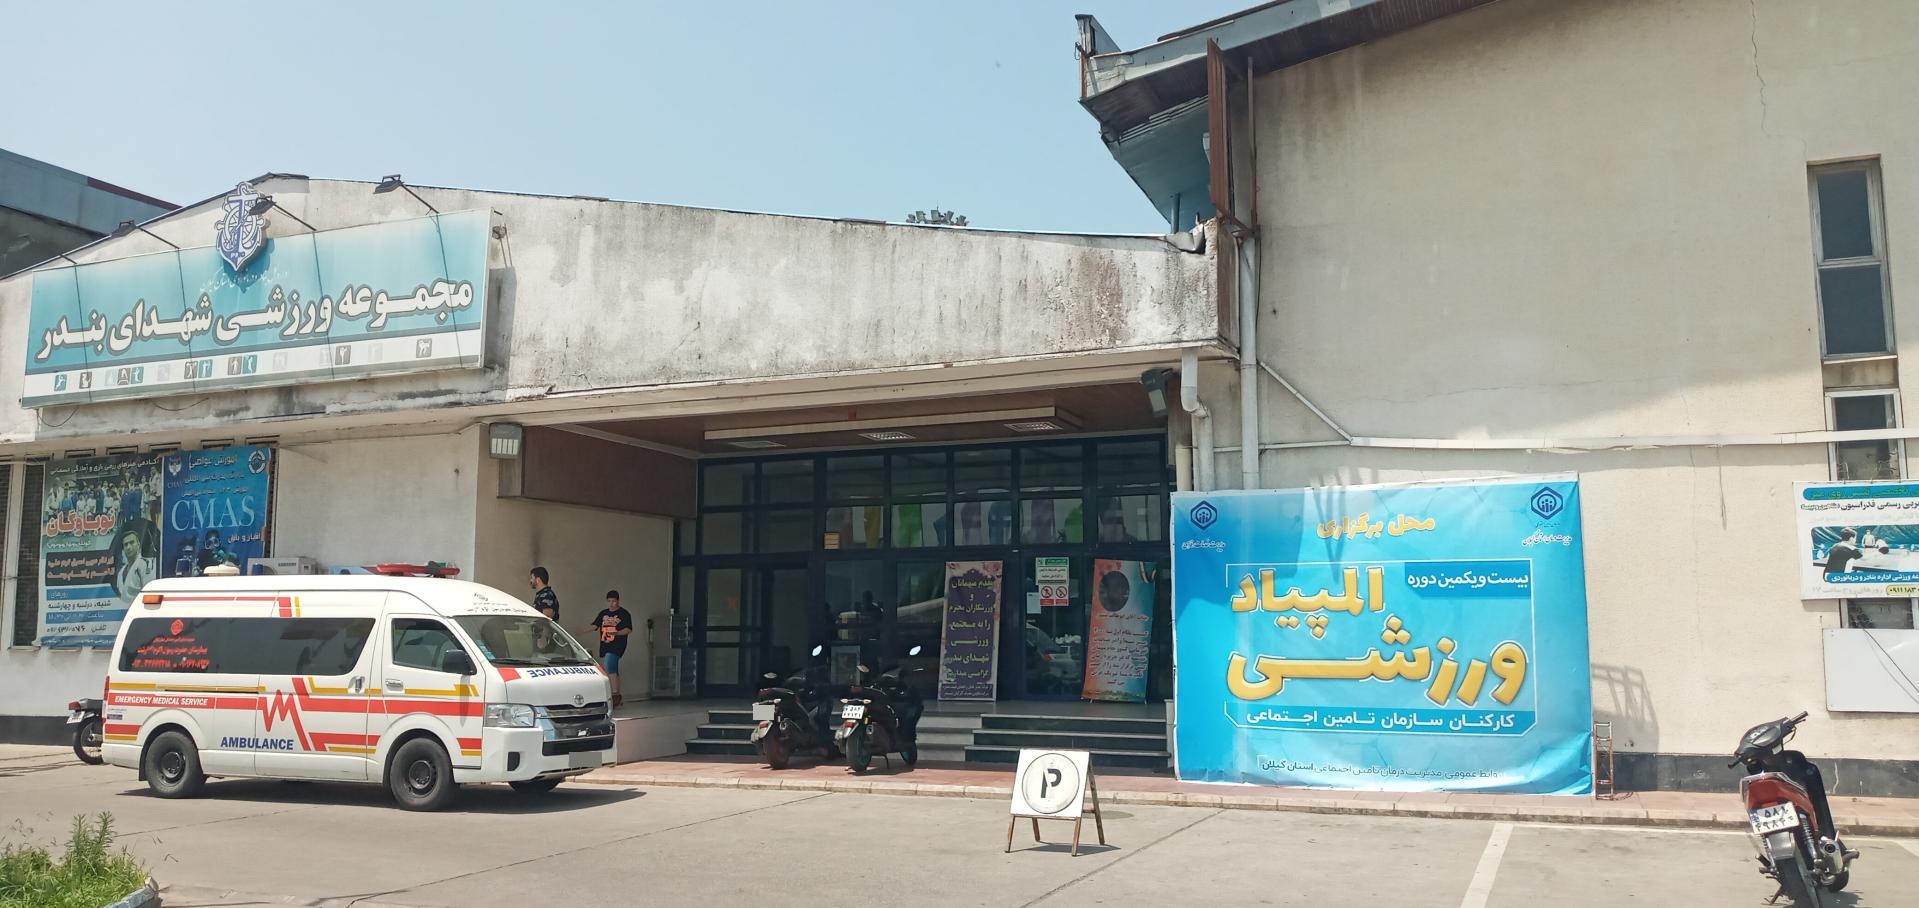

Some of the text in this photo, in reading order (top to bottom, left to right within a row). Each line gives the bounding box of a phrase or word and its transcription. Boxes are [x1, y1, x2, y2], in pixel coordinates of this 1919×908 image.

[36, 279, 473, 361] مجموعه ورزشی شهدای بندر
[1840, 500, 1876, 511] فدراسیون
[1877, 502, 1902, 511] رسمی
[1903, 500, 1919, 510] ربی
[171, 495, 257, 531] CMAS
[47, 508, 117, 537] نوباوگان
[1317, 512, 1436, 541] محل برگزاری
[1407, 573, 1437, 588] دوره
[1231, 565, 1384, 639] المپیاد
[1226, 616, 1528, 706] ورزشی
[114, 695, 209, 706] EMERGENCY MEDICAL SERVICE
[1246, 708, 1515, 732] کارکنان سازمان تامین اجتماعی
[220, 736, 295, 750] AMBULANCE
[1262, 760, 1286, 770] گیلان
[1288, 762, 1314, 772] استان
[1380, 767, 1406, 778] درمان
[1445, 770, 1478, 780] عمومی
[1040, 768, 1062, 799] P
